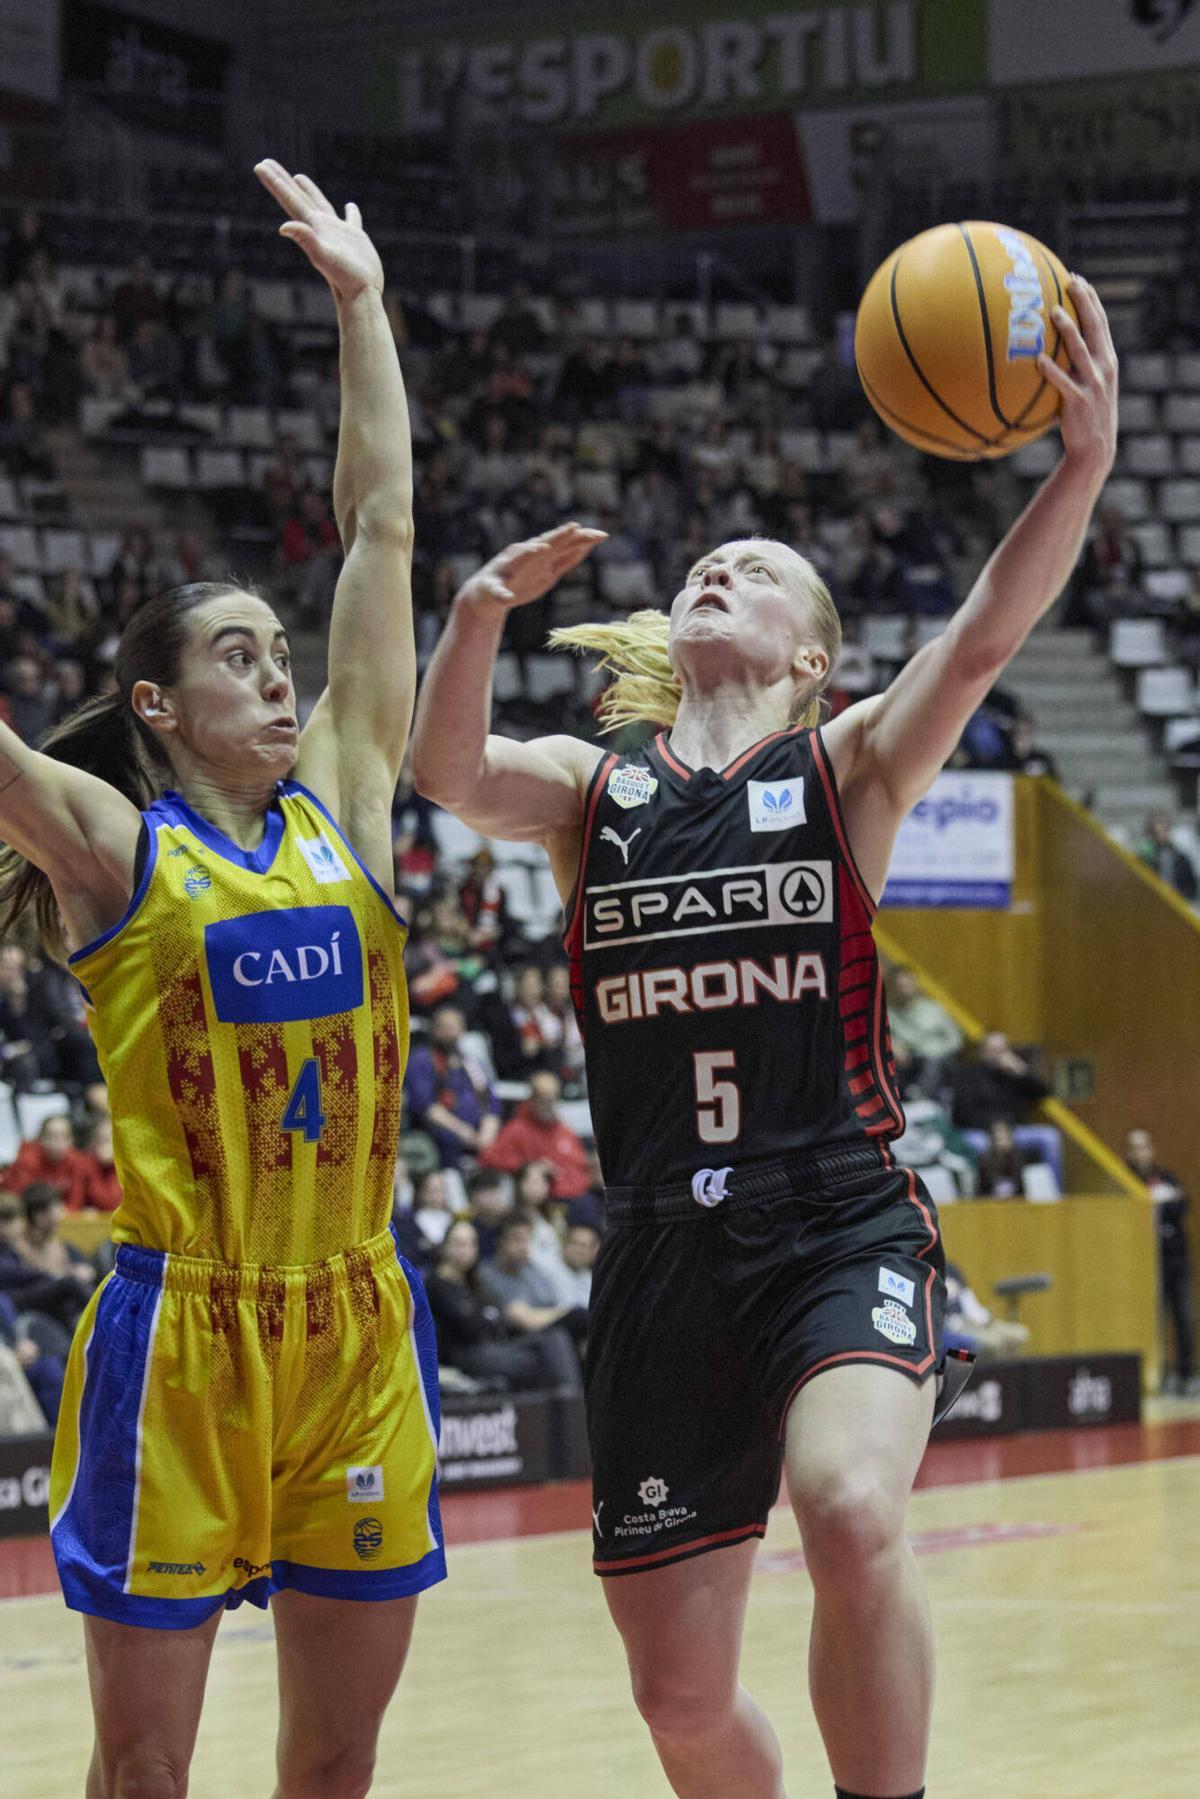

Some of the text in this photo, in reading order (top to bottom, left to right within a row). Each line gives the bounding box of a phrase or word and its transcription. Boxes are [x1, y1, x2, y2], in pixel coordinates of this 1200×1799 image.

[400, 3, 914, 133] L'ESPORTIU
[610, 784, 649, 801] GIRONA
[594, 880, 764, 933] SPAR
[232, 930, 343, 988] CADÍ
[596, 953, 828, 1024] GIRONA
[280, 1057, 328, 1143] 4
[693, 1050, 740, 1143] 5
[624, 1506, 687, 1525] Costa Brava
[645, 1485, 662, 1499] G!
[614, 1526, 652, 1537] Pirineu
